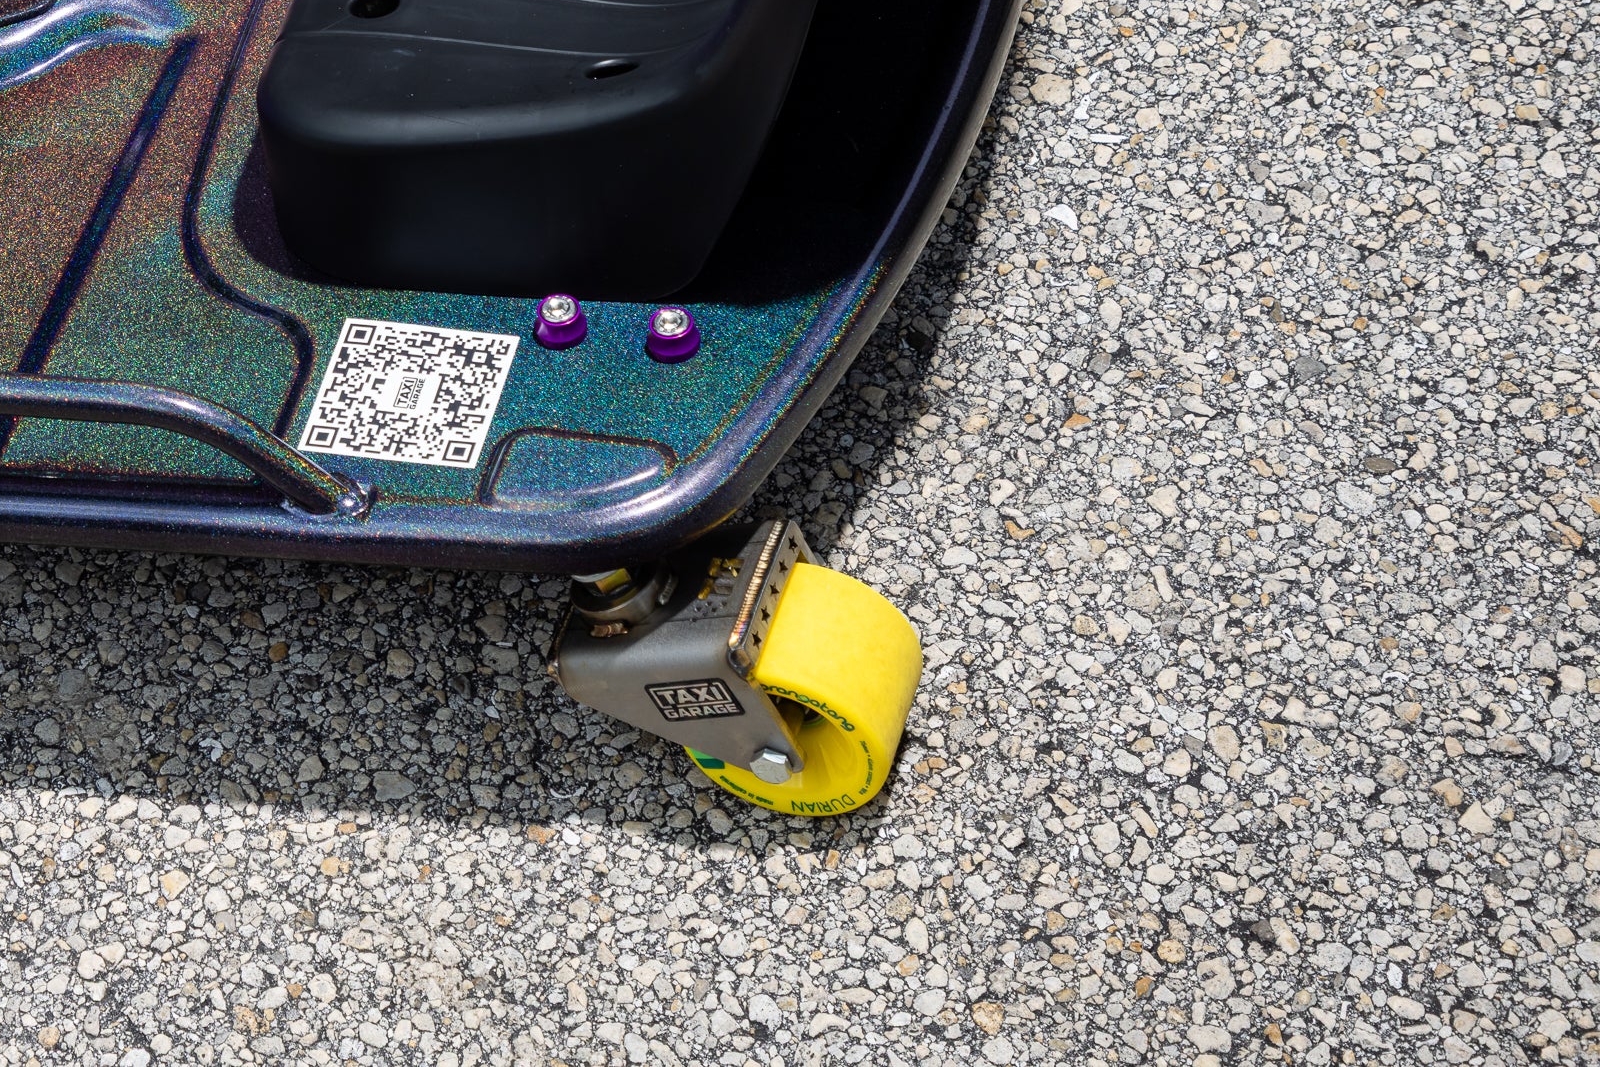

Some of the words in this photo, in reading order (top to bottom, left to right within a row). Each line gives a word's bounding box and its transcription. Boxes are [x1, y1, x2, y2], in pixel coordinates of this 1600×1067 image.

[397, 380, 414, 405] TAXI
[409, 378, 425, 409] GARAGE
[656, 686, 723, 704] TAXI
[663, 703, 740, 718] GARAGE
[791, 794, 856, 813] DURIAN
